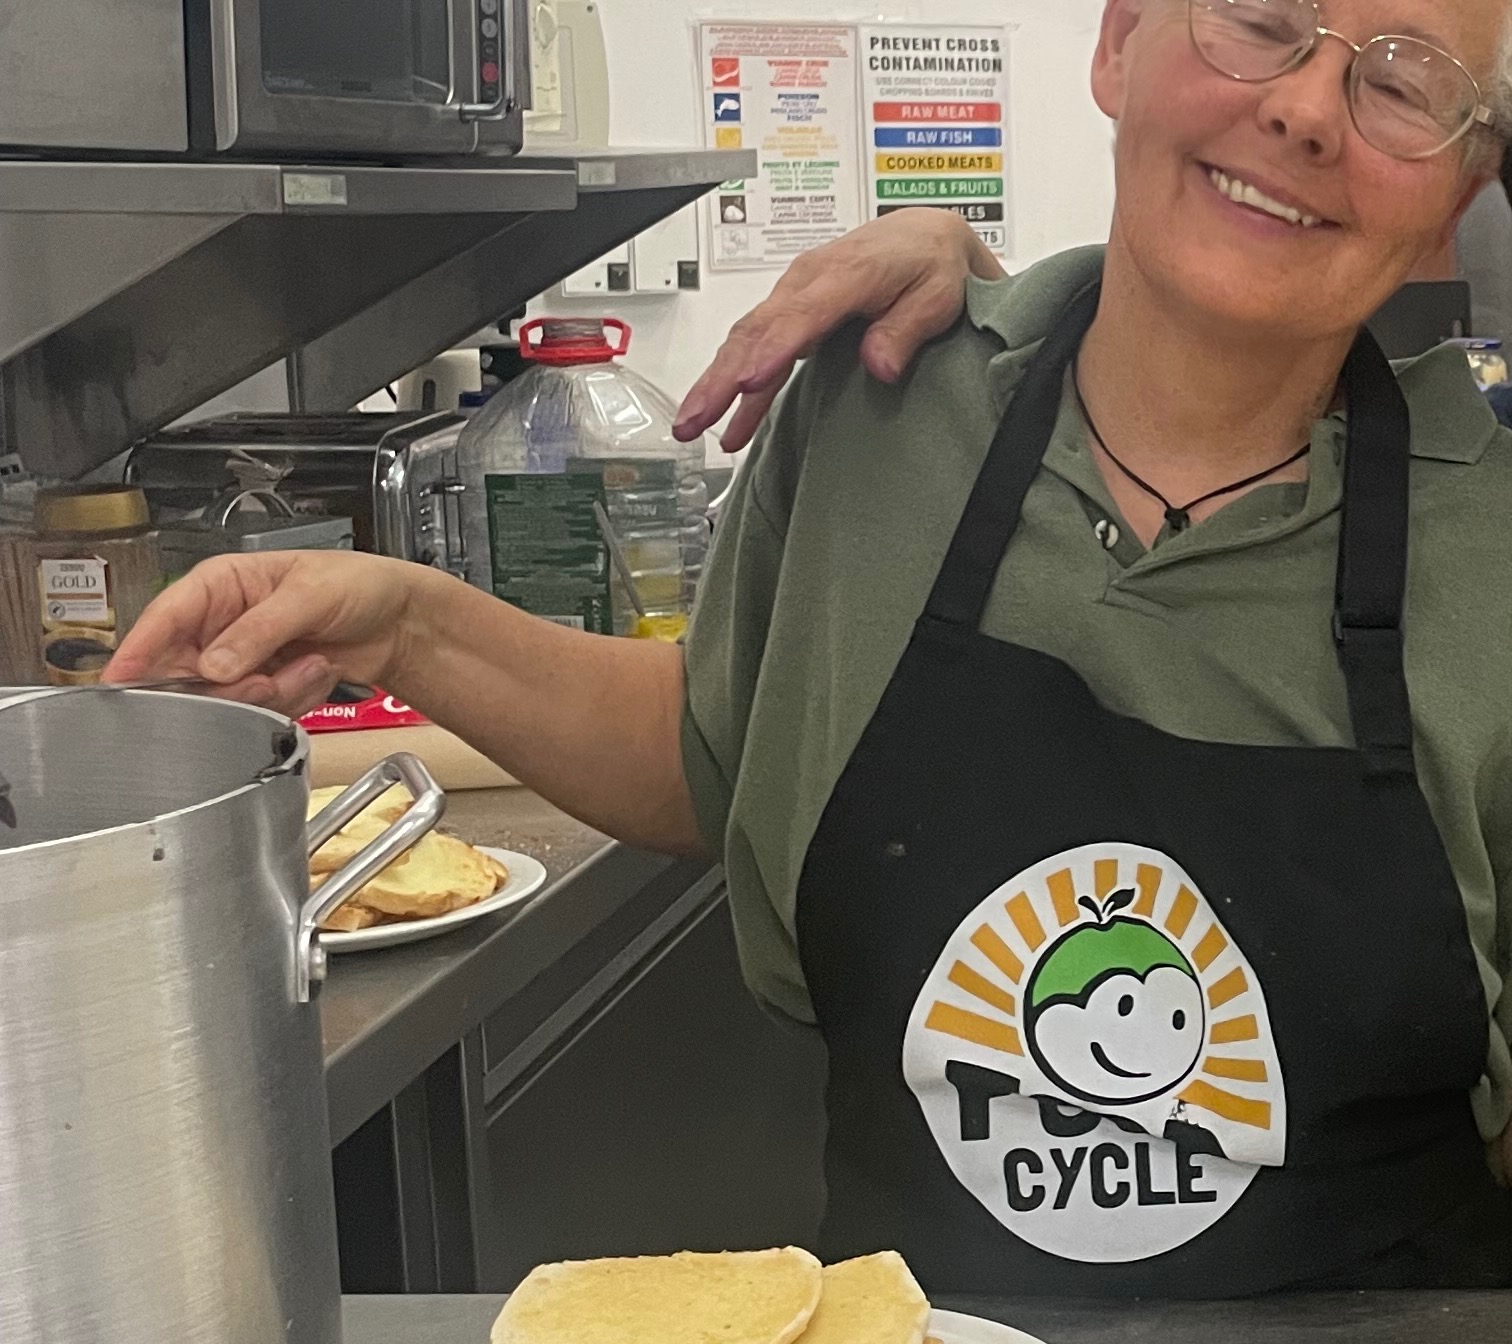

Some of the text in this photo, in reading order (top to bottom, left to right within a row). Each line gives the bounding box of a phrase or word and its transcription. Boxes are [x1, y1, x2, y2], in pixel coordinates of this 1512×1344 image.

[870, 36, 1000, 52] PREVENT CROSS
[869, 56, 1002, 72] CONTAMINATION
[901, 105, 975, 119] RAW MEAT
[906, 130, 972, 144] RAW FISH
[886, 156, 993, 170] COOKED MEATS
[883, 180, 998, 196] SALADS & FRUITS
[52, 575, 96, 588] GOLD
[1003, 1141, 1218, 1213] CYCLE
